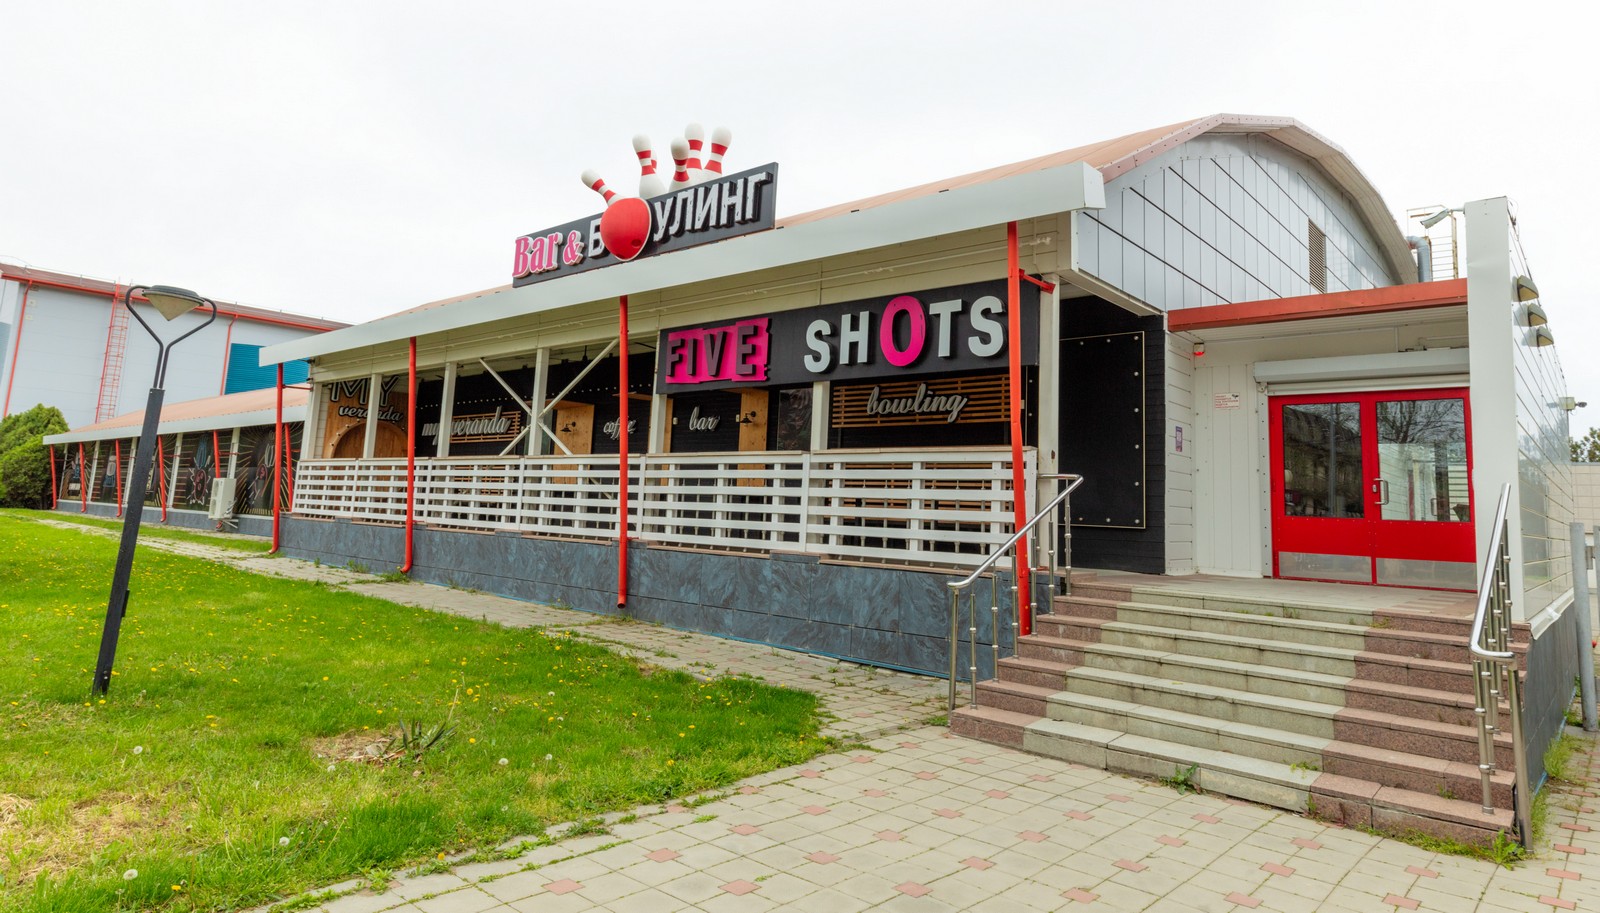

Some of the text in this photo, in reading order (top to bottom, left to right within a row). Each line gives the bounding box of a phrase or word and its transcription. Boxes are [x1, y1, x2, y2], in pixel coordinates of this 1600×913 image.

[512, 231, 562, 278] Bar
[563, 230, 584, 266] &
[666, 294, 1007, 377] FIVE SHOTS
[331, 375, 400, 406] MY
[866, 382, 968, 424] bowling
[451, 405, 512, 437] veranda
[689, 405, 720, 431] bar
